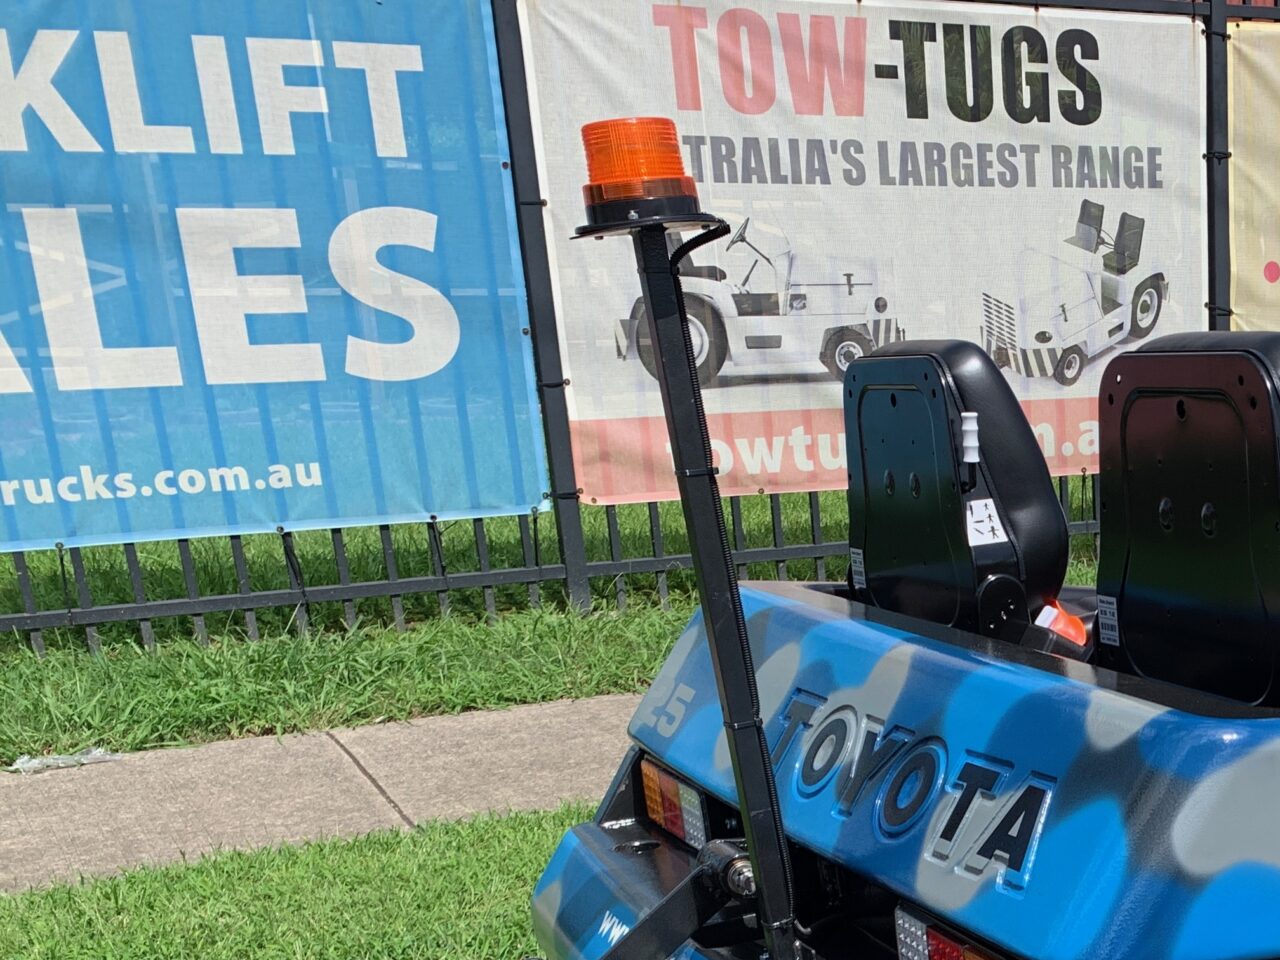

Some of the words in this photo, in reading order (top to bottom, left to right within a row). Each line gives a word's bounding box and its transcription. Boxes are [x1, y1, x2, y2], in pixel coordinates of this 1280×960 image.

[682, 135, 867, 186] TRALIA'S
[878, 140, 1041, 190] LARGEST
[1052, 145, 1164, 190] RANGE
[0, 206, 461, 393] LES
[642, 684, 696, 739] 25
[772, 688, 1058, 897] TOYOTA
